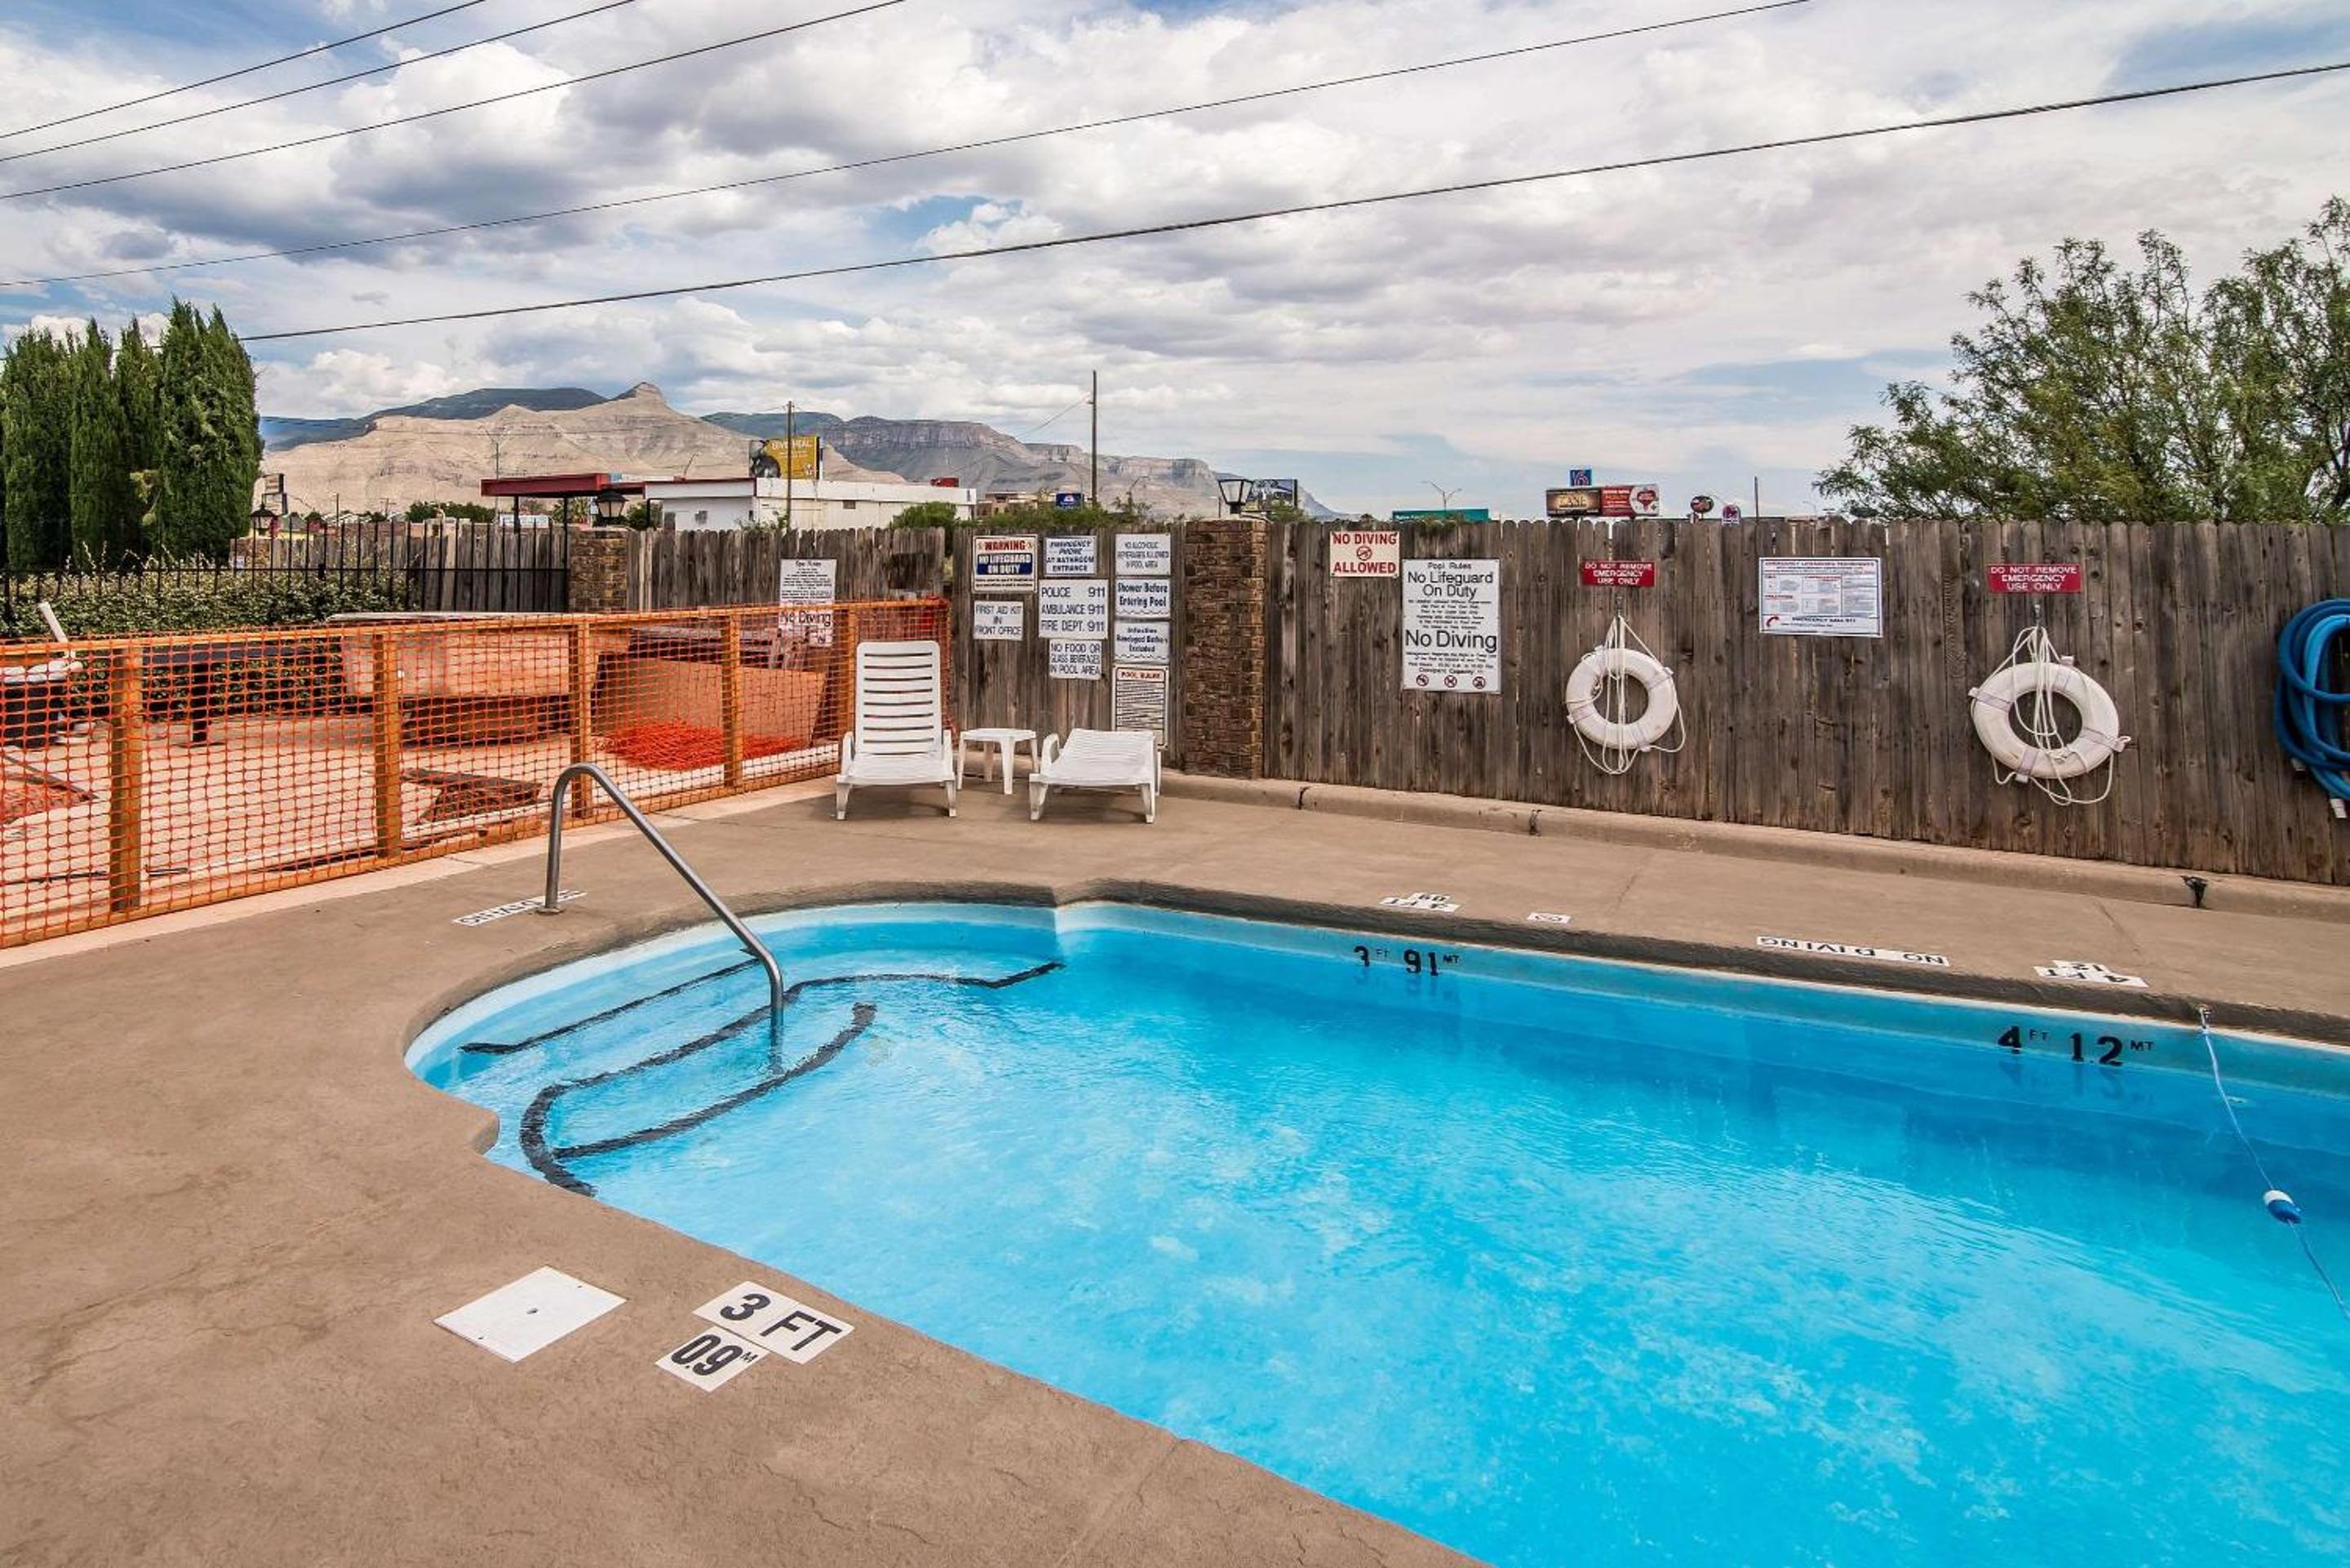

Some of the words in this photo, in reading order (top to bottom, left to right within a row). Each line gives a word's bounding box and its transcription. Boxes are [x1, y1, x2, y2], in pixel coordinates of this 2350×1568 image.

[1333, 534, 1350, 544] NO
[1355, 534, 1397, 545] DIVING
[985, 540, 1026, 551] WARNING
[978, 555, 989, 564] NO
[990, 554, 1031, 563] LIFEGUARD
[988, 564, 999, 574] ON
[1000, 564, 1021, 574] DUTY
[1334, 562, 1396, 574] ALLOWED
[1428, 562, 1445, 570] Pool
[1585, 561, 1597, 569] DO
[1408, 571, 1426, 583] No
[1430, 571, 1493, 587] Lifeguard
[1041, 587, 1071, 597] POLICE
[1089, 587, 1106, 597] 911
[1118, 582, 1142, 592] Shower
[1144, 582, 1168, 592] Before
[1422, 584, 1443, 596] On
[1447, 584, 1477, 600] Duty
[2006, 582, 2029, 591] USE
[2034, 582, 2062, 591] ONLY
[1120, 596, 1147, 608] Entering
[1150, 596, 1166, 606] Pool
[976, 605, 994, 614] FIRST
[996, 606, 1008, 614] AID
[1010, 605, 1022, 614] KIT
[1041, 604, 1085, 614] AMBULANCE
[1088, 605, 1105, 614] 911
[993, 616, 1002, 625] IN
[1041, 620, 1058, 631] FIRE
[1062, 620, 1084, 631] DEPT.
[1087, 621, 1104, 631] 911
[976, 626, 995, 635] FRONT
[998, 627, 1022, 636] OFFICE
[1405, 629, 1432, 647] No
[1436, 630, 1496, 653] Diving
[1051, 643, 1062, 652] NO
[1065, 643, 1086, 653] FOOD
[1089, 643, 1101, 653] OR
[1050, 664, 1057, 673] IN
[1059, 664, 1078, 674] POOL
[1081, 665, 1101, 675] AREA
[1758, 937, 1876, 957] DIVING
[1376, 948, 1390, 958] FT
[1443, 954, 1461, 963] MT
[1903, 952, 1945, 964] NO
[1998, 1025, 2022, 1054] 4
[2029, 1029, 2049, 1041] FT
[2131, 1040, 2155, 1052] MT
[720, 1293, 771, 1321] 3
[760, 1310, 842, 1351] FT
